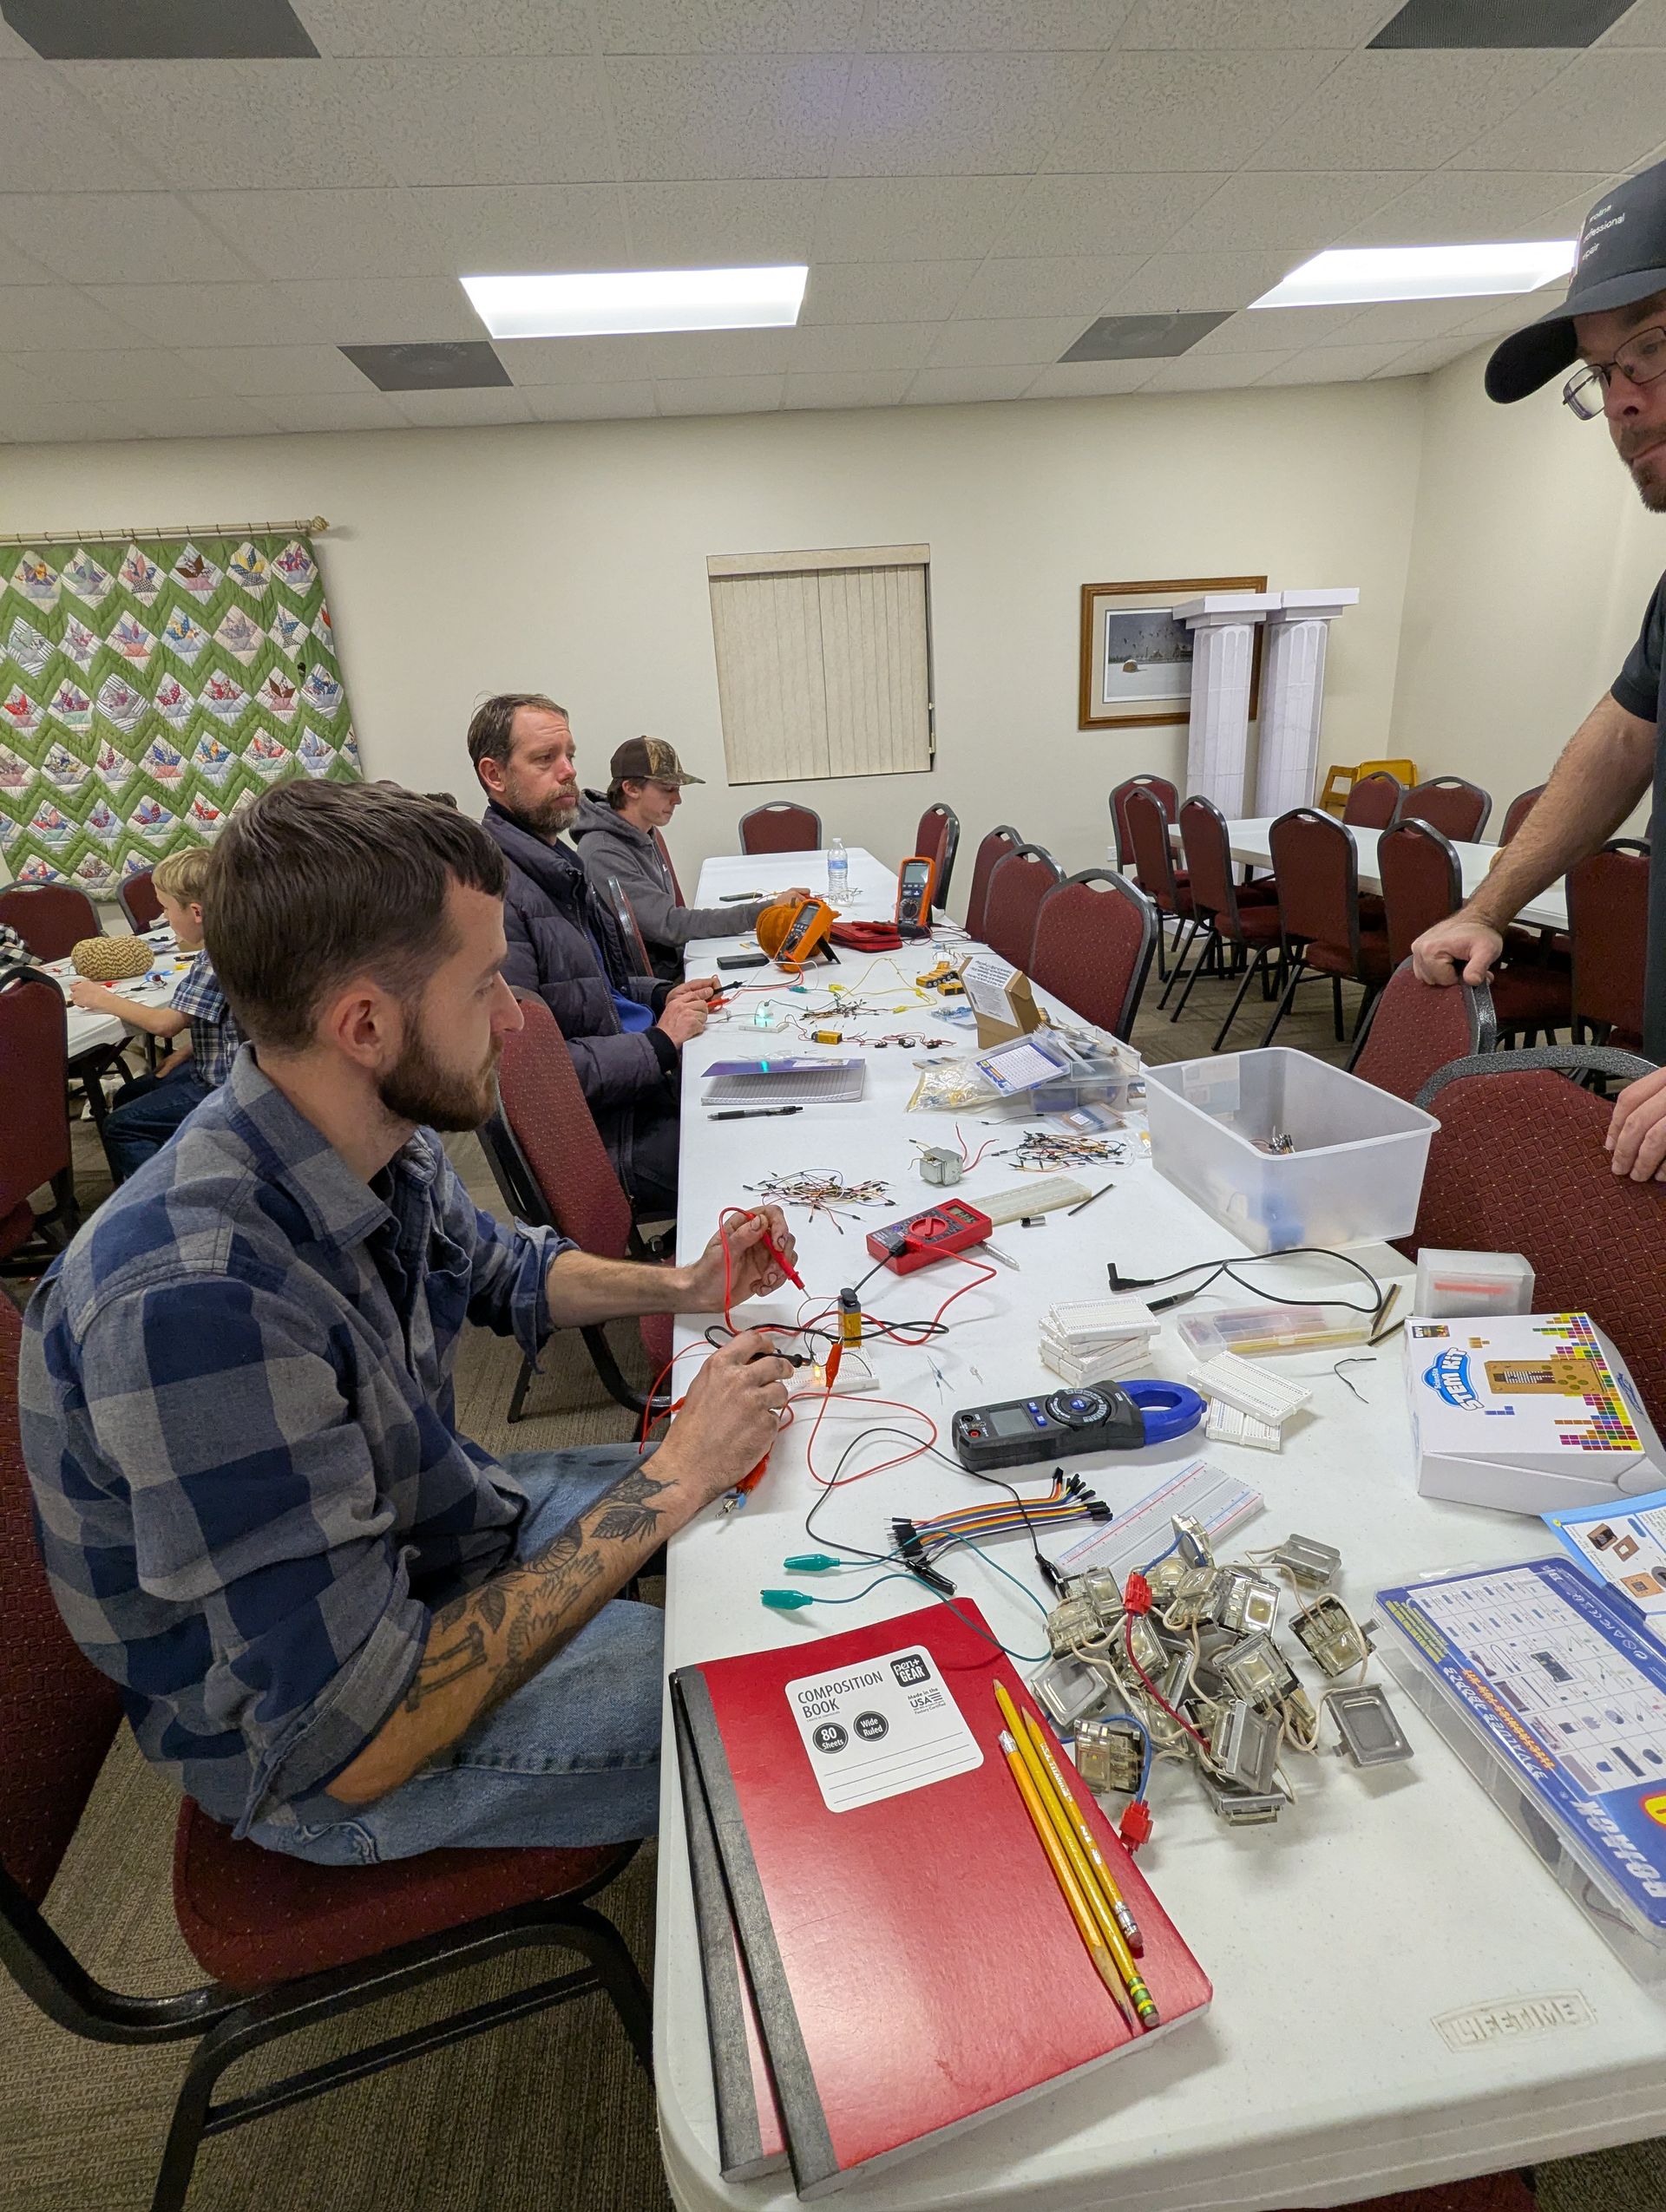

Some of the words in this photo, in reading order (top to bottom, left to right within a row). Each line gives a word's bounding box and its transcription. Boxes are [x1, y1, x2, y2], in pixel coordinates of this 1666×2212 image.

[1441, 1372, 1485, 1410] STEM
[899, 1666, 926, 1683] GEAR
[797, 1671, 883, 1704] COMPOSITION
[908, 1692, 922, 1700] Made
[909, 1696, 933, 1709] USA
[802, 1698, 840, 1718] BOOK
[860, 1718, 878, 1728] Wide
[863, 1724, 883, 1737] Ruled
[821, 1726, 836, 1741] 80
[822, 1739, 844, 1750] Sheets
[1450, 1999, 1582, 2045] LIFETIME
